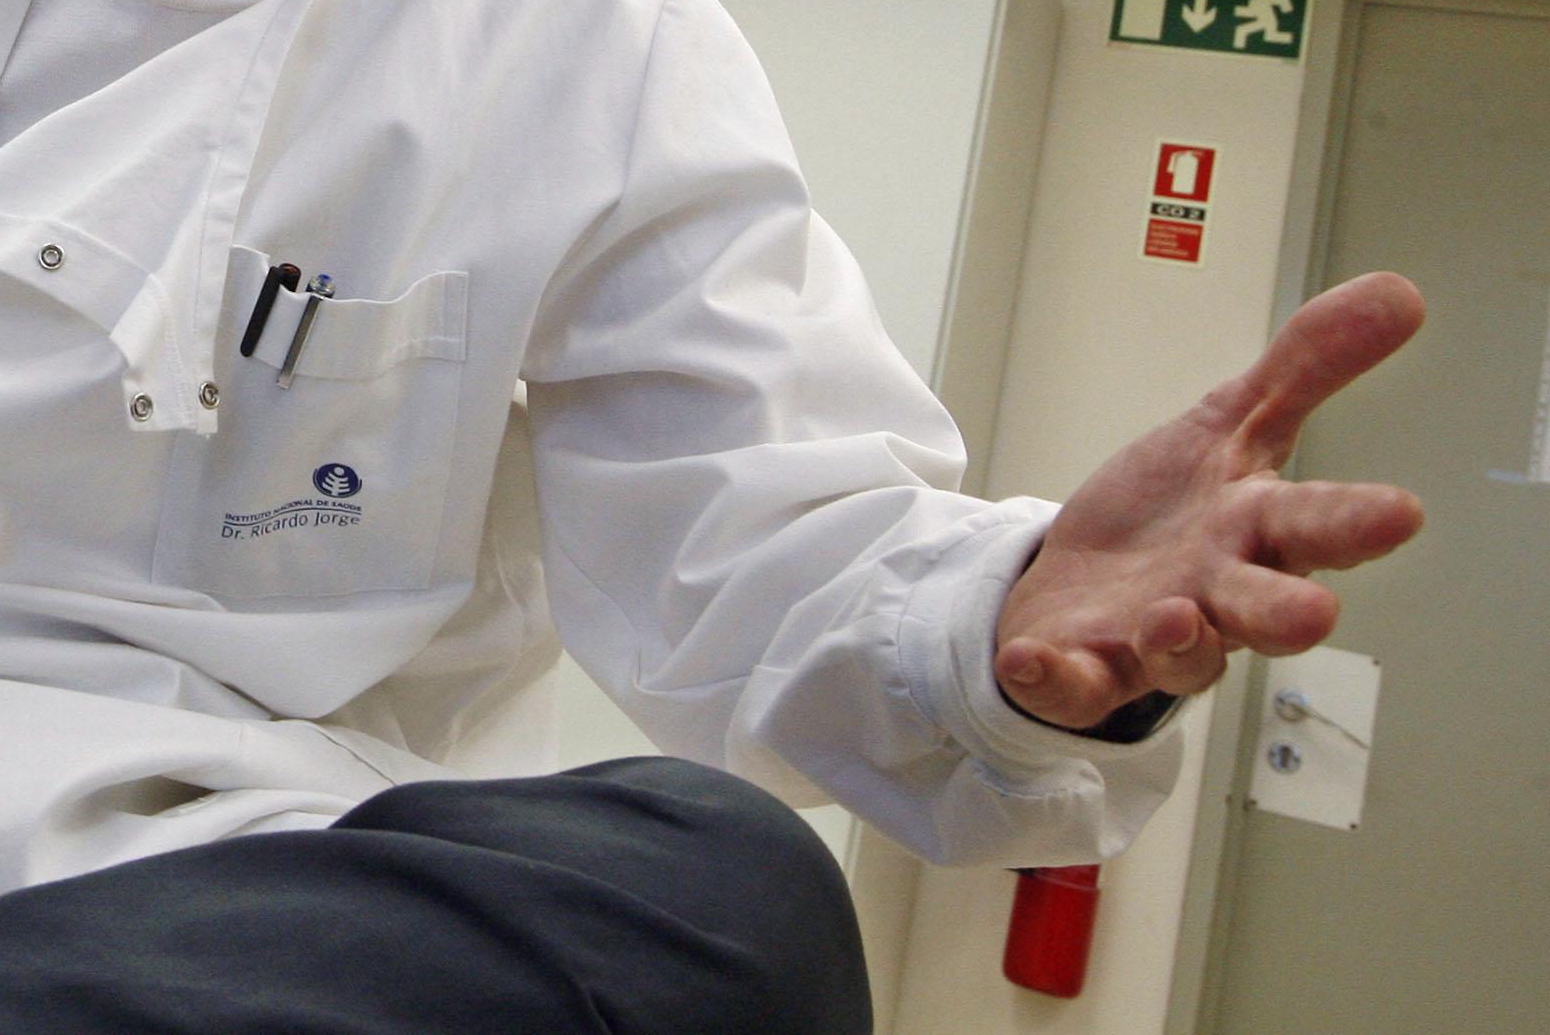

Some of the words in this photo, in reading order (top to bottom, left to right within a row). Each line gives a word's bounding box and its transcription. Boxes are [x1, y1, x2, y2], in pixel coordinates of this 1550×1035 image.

[221, 526, 244, 540] Dr.
[250, 513, 308, 538] Ricardo
[314, 512, 361, 527] Jorge
[225, 512, 271, 523] INSTITUTO
